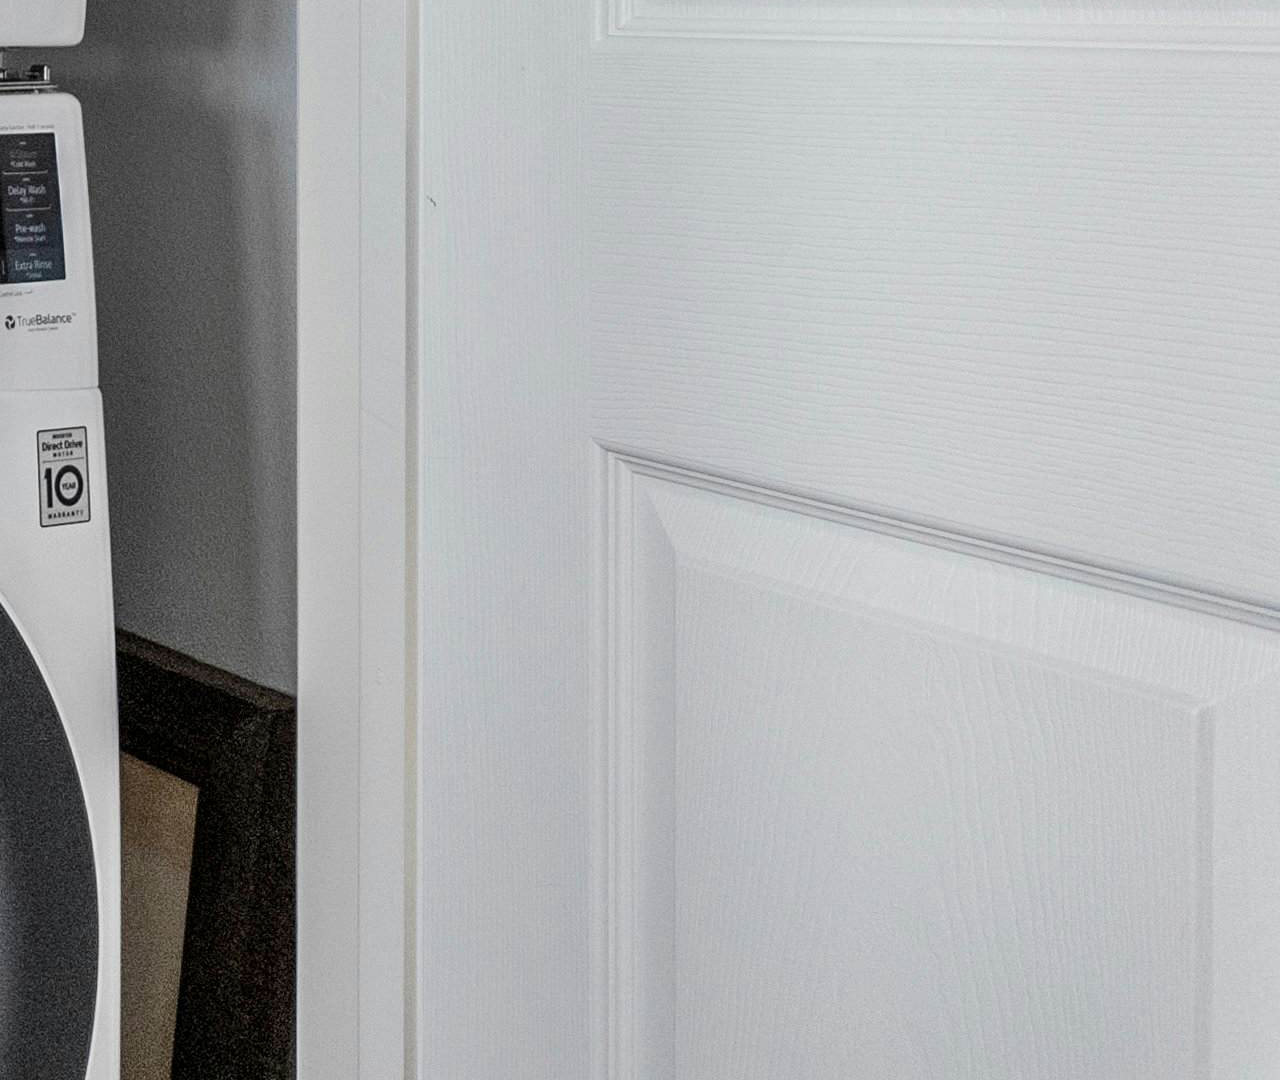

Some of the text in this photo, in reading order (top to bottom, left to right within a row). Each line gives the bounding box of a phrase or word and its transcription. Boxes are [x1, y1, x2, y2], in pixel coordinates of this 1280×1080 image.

[42, 439, 83, 452] Direct Drive
[44, 465, 84, 508] 10
[62, 481, 76, 490] YEAR
[48, 510, 84, 520] WARRANTY
